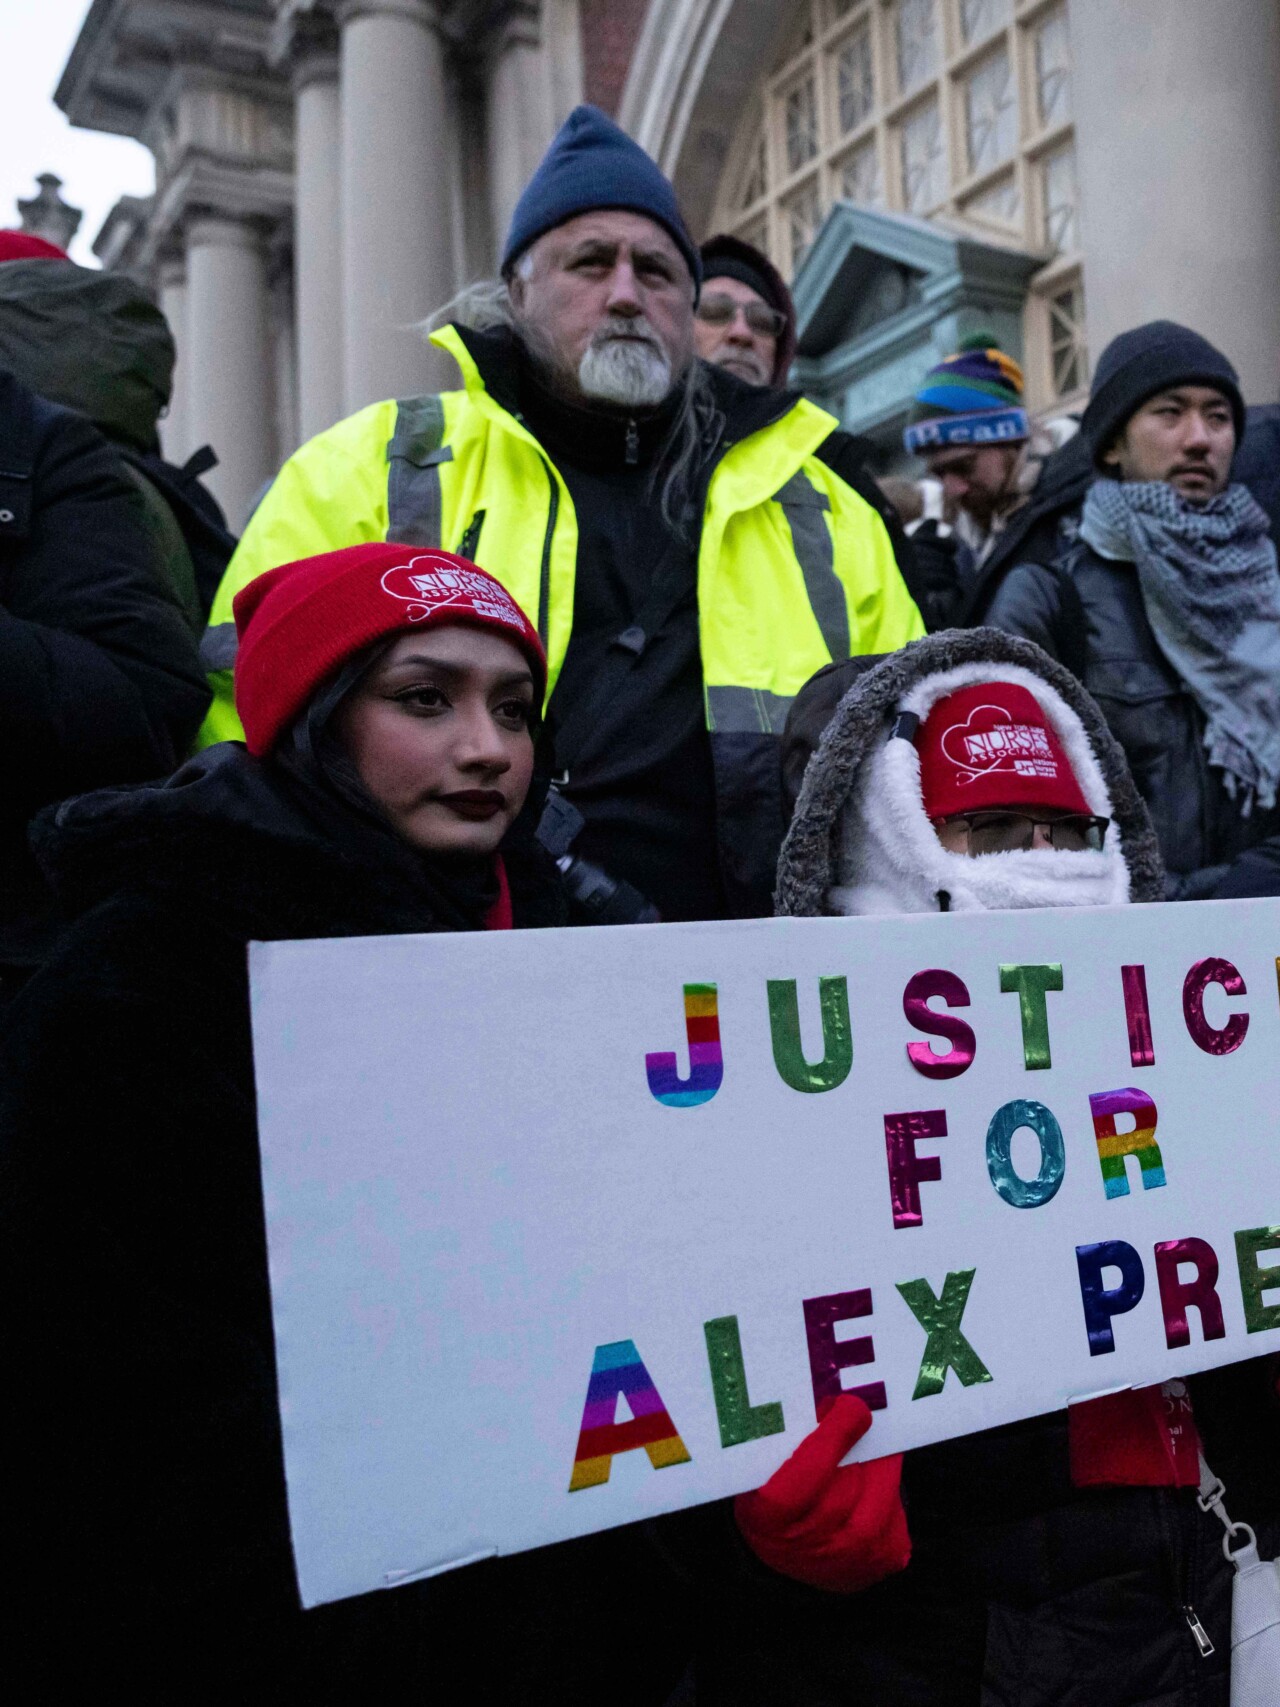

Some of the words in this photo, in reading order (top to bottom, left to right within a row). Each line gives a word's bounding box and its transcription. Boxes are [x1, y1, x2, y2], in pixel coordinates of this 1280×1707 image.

[963, 730, 1050, 757] NURSES
[970, 748, 1054, 764] ASSOCIATION
[884, 1087, 1167, 1229] FOR
[568, 1266, 994, 1493] ALEX
